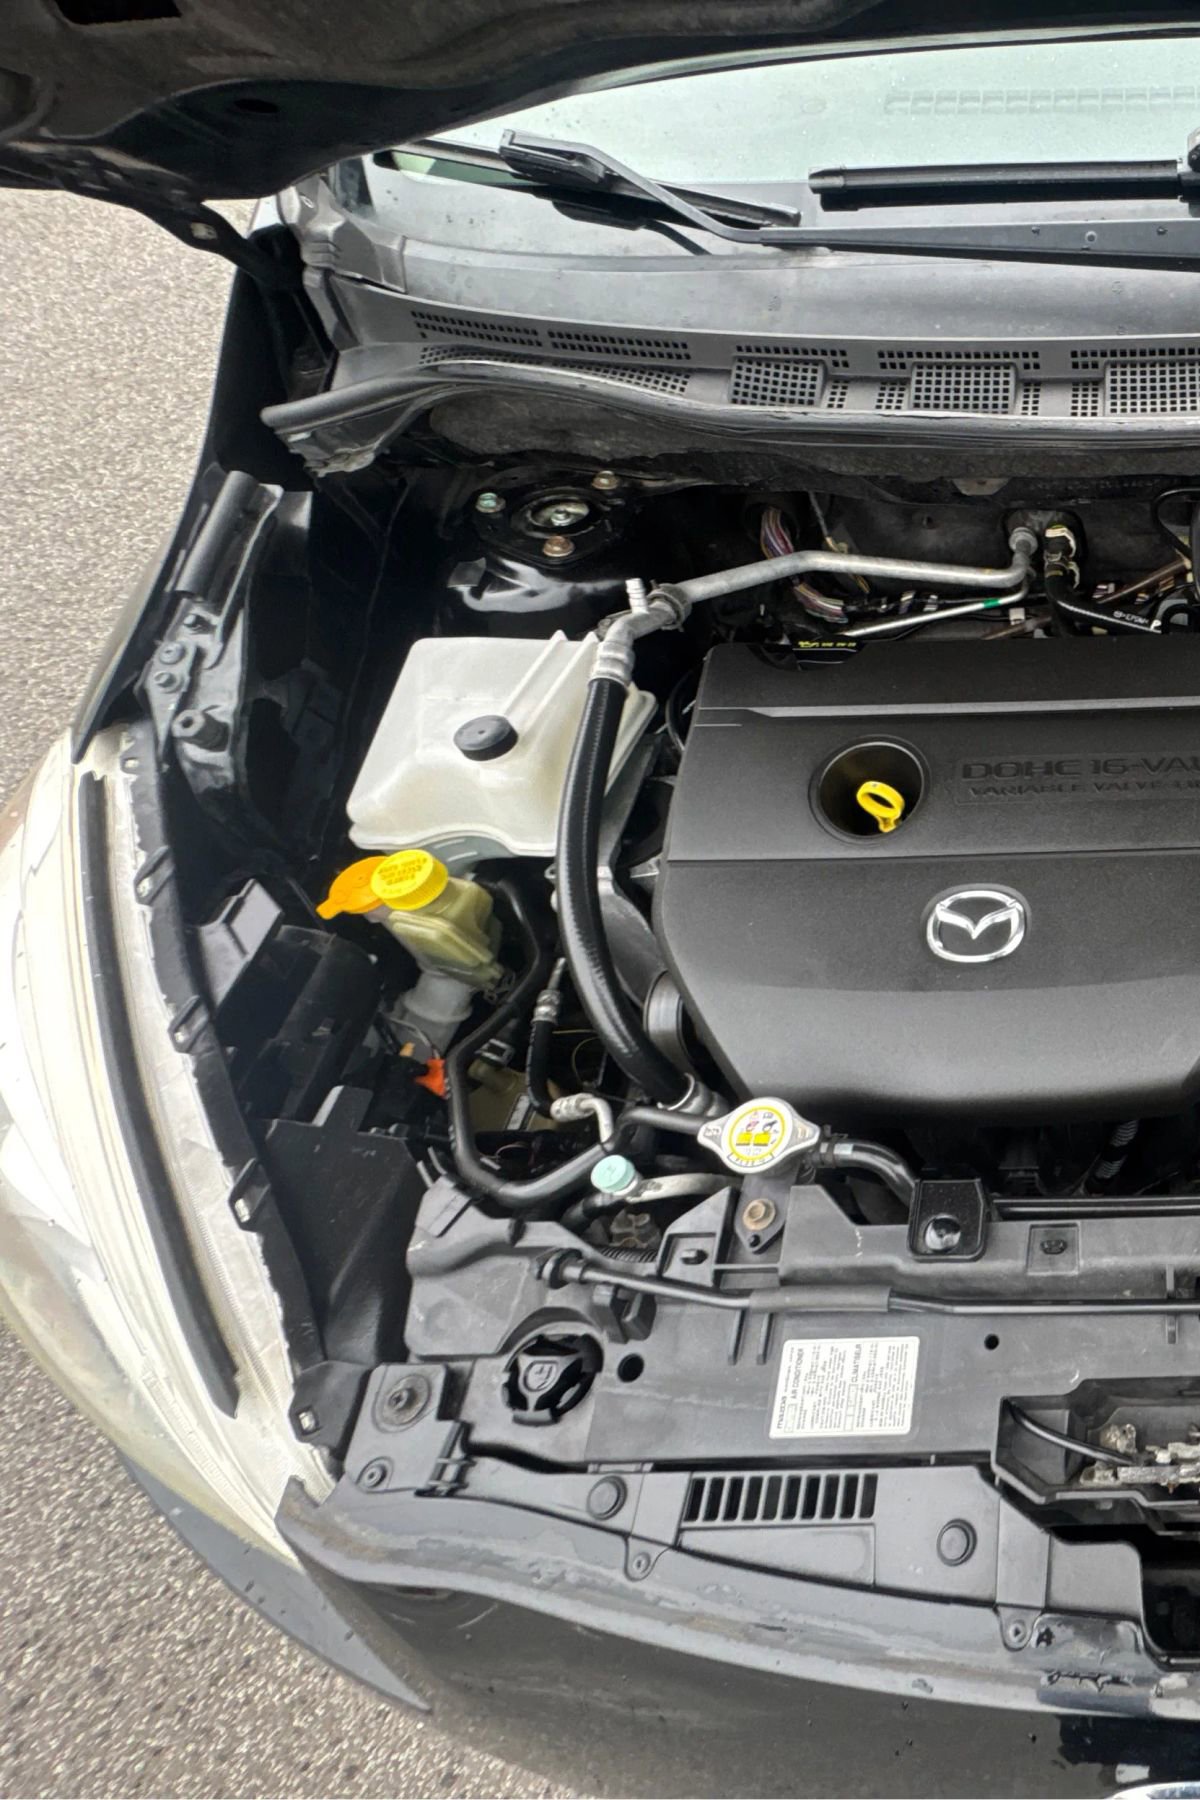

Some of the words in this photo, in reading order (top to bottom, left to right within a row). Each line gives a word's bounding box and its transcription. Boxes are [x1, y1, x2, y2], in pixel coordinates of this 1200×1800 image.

[962, 760, 1081, 780] DOHC
[970, 782, 1086, 796] VARIABLE
[1093, 780, 1162, 792] VALVE
[792, 1347, 804, 1388] CONDITIONER
[790, 1389, 798, 1399] AIR
